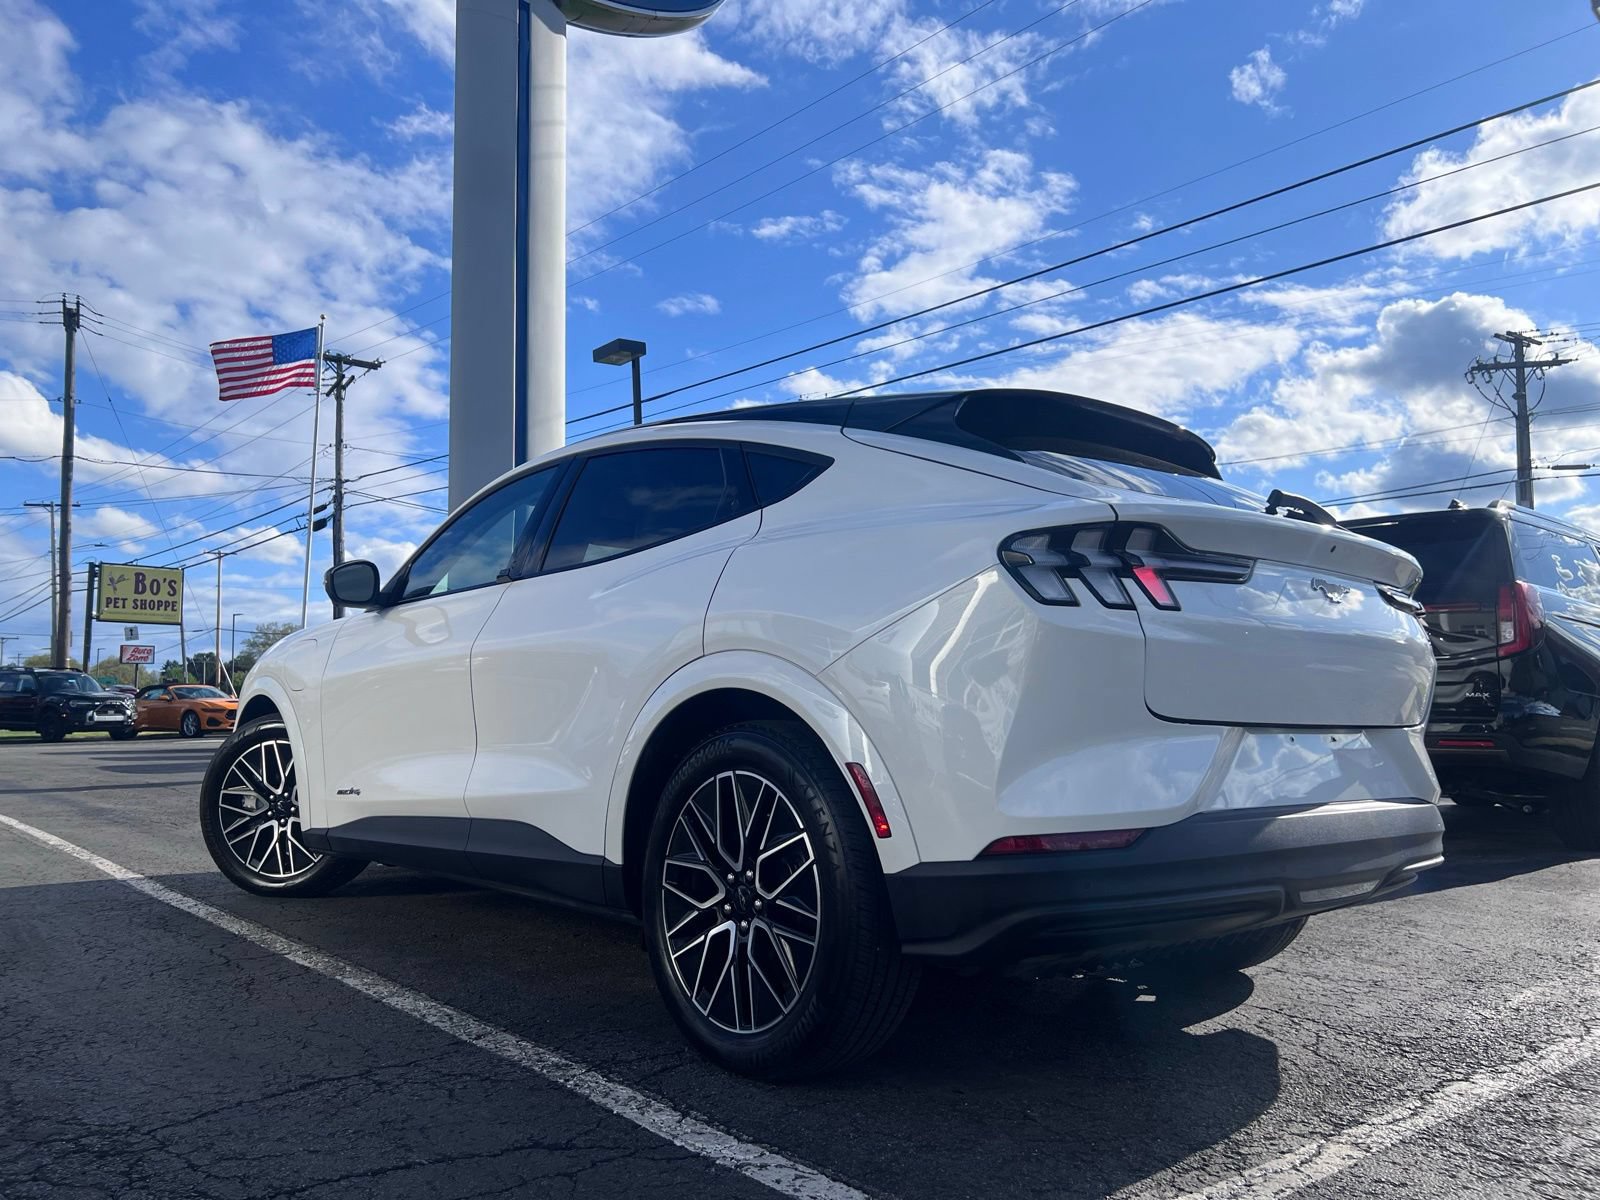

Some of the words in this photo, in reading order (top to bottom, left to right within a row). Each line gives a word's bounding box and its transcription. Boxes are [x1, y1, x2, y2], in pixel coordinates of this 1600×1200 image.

[105, 597, 128, 609] PET
[132, 598, 178, 612] SHOPPE
[131, 647, 152, 655] Auto
